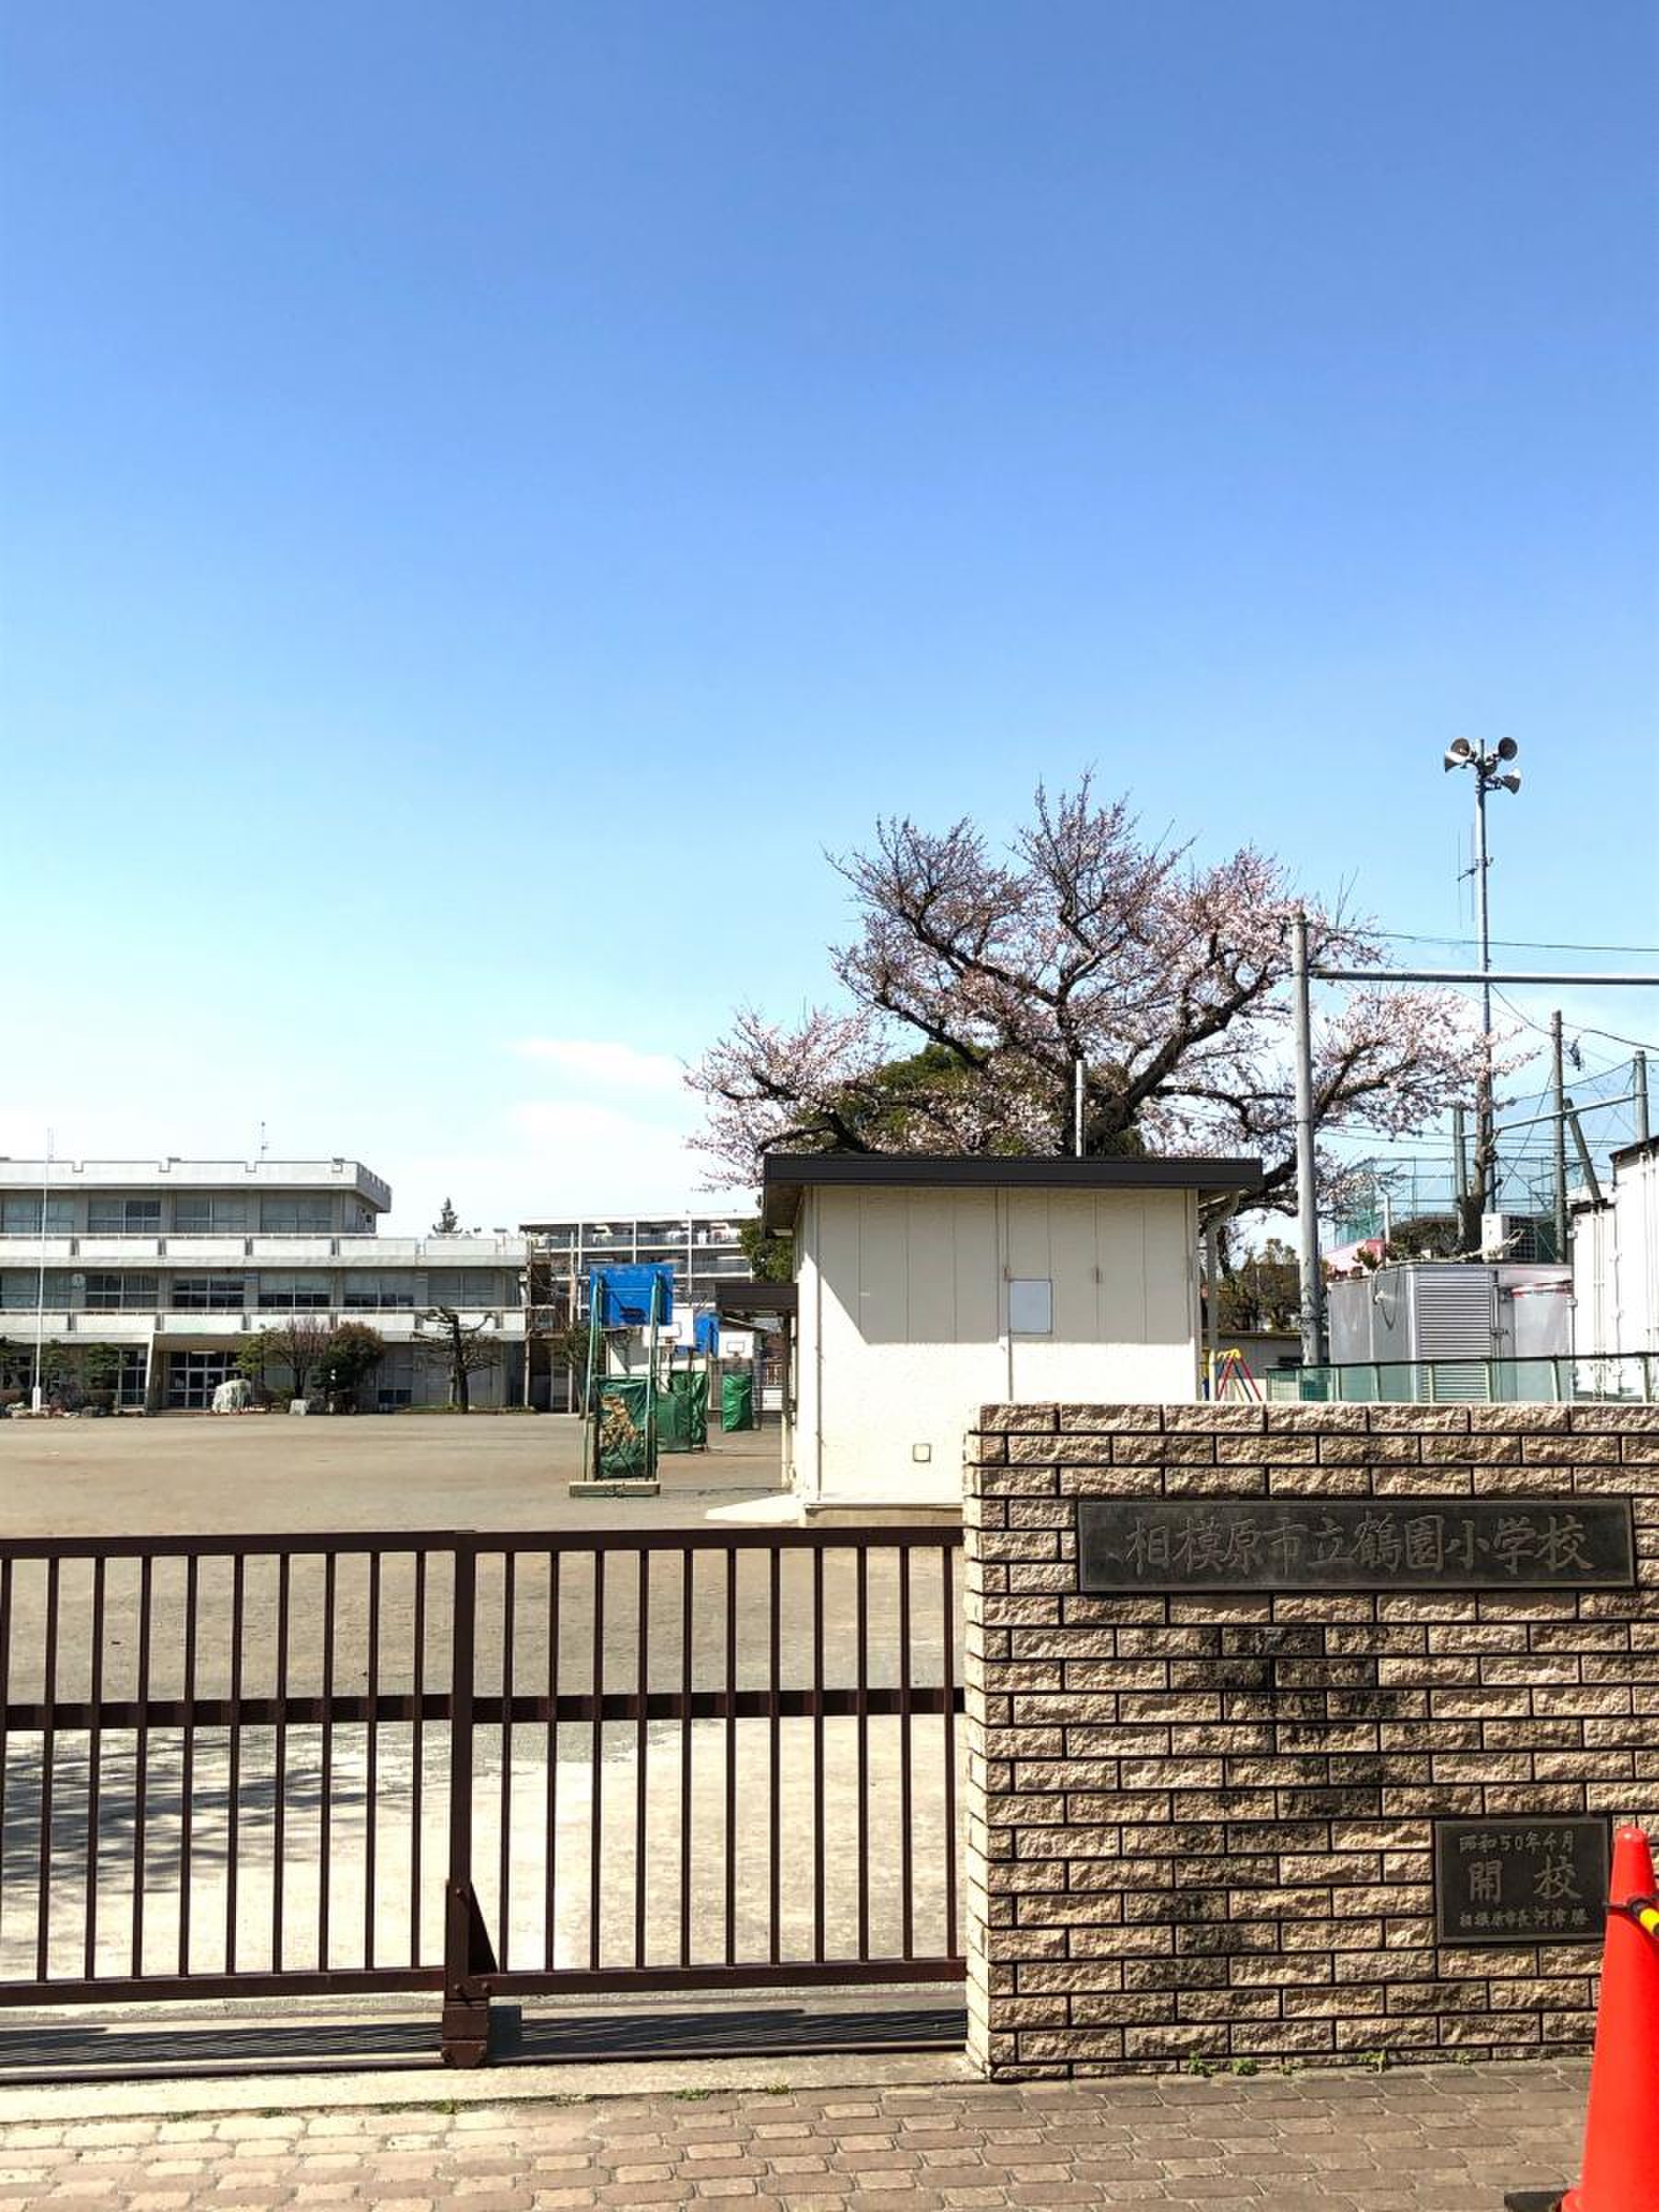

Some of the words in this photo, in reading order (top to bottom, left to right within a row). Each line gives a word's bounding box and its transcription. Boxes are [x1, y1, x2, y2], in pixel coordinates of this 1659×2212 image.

[1124, 1508, 1595, 1576] 相模原市立鶴園小学校
